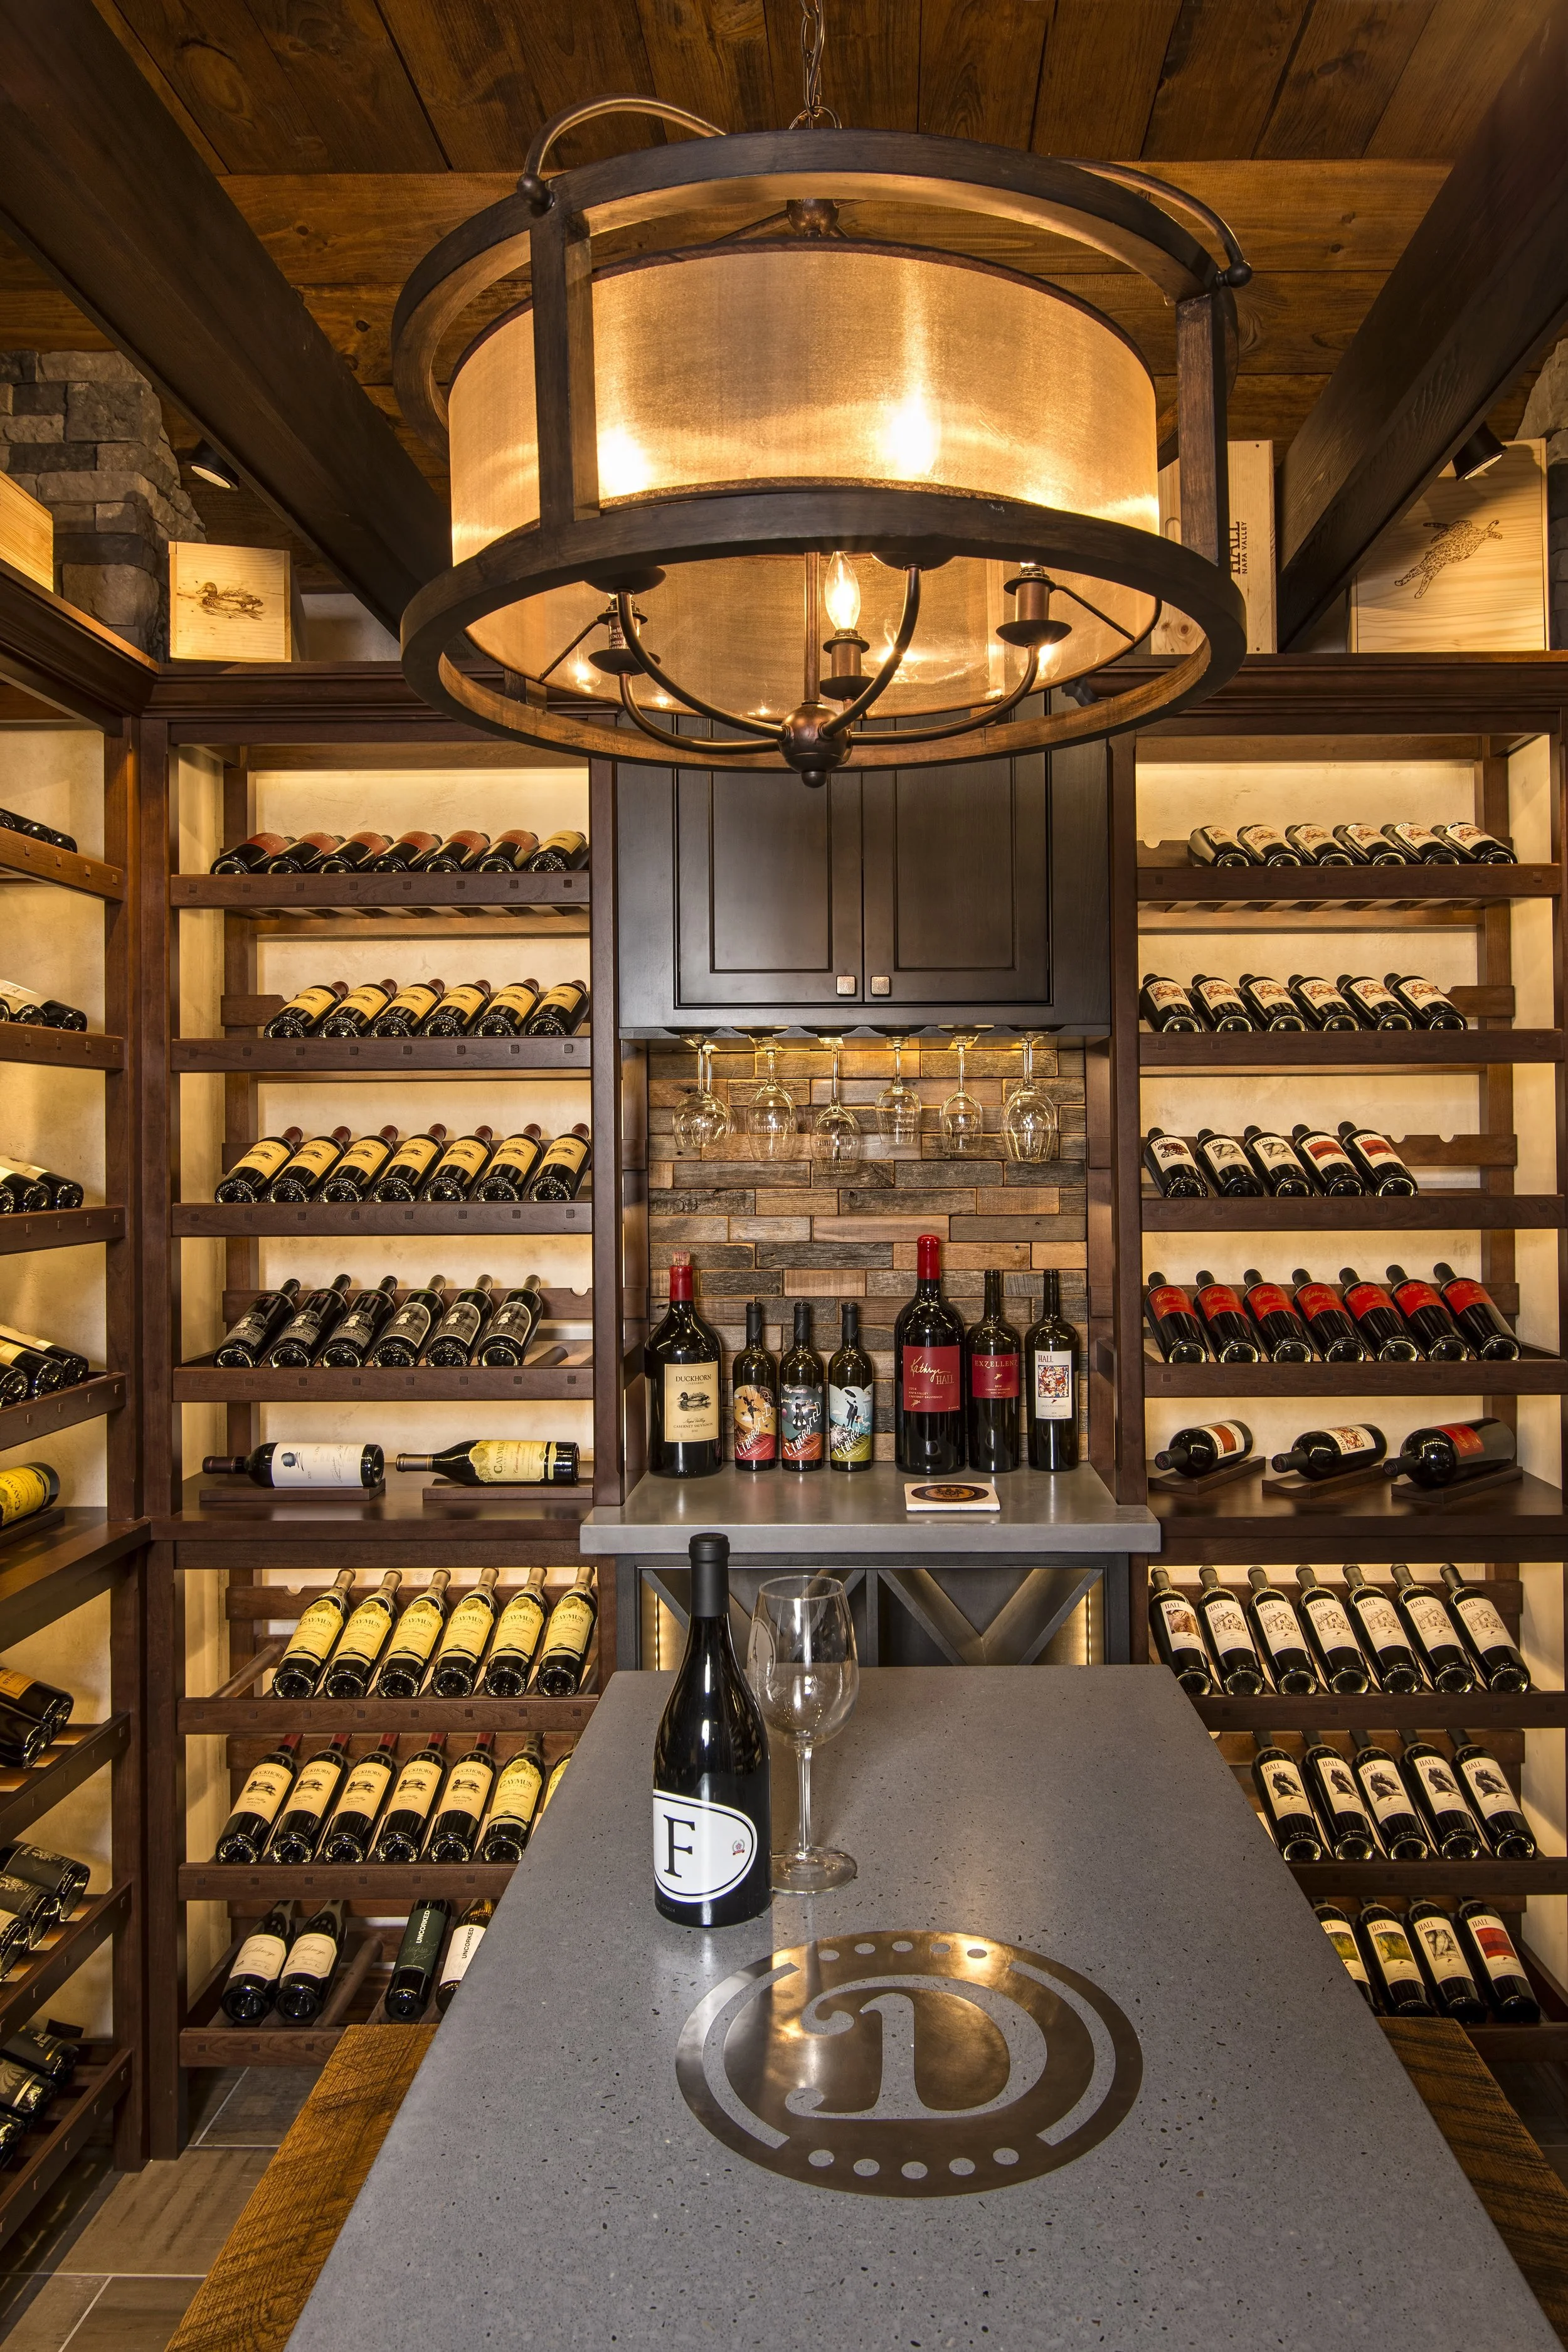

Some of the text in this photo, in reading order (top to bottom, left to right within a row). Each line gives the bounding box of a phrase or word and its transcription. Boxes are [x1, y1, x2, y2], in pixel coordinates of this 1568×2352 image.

[1229, 521, 1241, 575] HALL
[1355, 980, 1370, 988] HALL
[1403, 980, 1419, 988] HALL
[1154, 1138, 1170, 1147] HALL
[1207, 1140, 1222, 1148] HALL
[1257, 1138, 1273, 1147] HALL
[1305, 1137, 1322, 1146] HALL
[1038, 1355, 1054, 1363] HALL
[975, 1360, 1019, 1369] EXZELLENZ
[936, 1375, 955, 1385] HALL
[736, 1402, 771, 1456] LIBERATED
[784, 1401, 822, 1456] LIBERATED
[1337, 1436, 1347, 1451] HALL
[1208, 1603, 1224, 1613] HALL
[1260, 1603, 1276, 1613] HALL
[1310, 1602, 1327, 1611] HALL
[1360, 1600, 1377, 1609] HALL
[1410, 1599, 1427, 1609] HALL
[1461, 1601, 1478, 1611] HALL
[299, 1617, 333, 1628] CAYMUS
[347, 1619, 381, 1628] CAYMUS
[400, 1618, 433, 1628] CAYMUS
[450, 1616, 484, 1624] CAYMUS
[502, 1614, 535, 1624] CAYMUS
[552, 1614, 584, 1624] CAYMUS
[1265, 1763, 1281, 1772] HALL
[1362, 1764, 1378, 1776] HALL
[1466, 1761, 1483, 1771] HALL
[499, 1778, 532, 1789] CAYMUS
[664, 1814, 696, 1878] F
[416, 1910, 430, 1944] UNCORKED
[1371, 1922, 1389, 1932] HALL
[1418, 1921, 1436, 1932] HALL
[1471, 1919, 1490, 1928] HALL
[462, 1927, 475, 1959] UNCORKED
